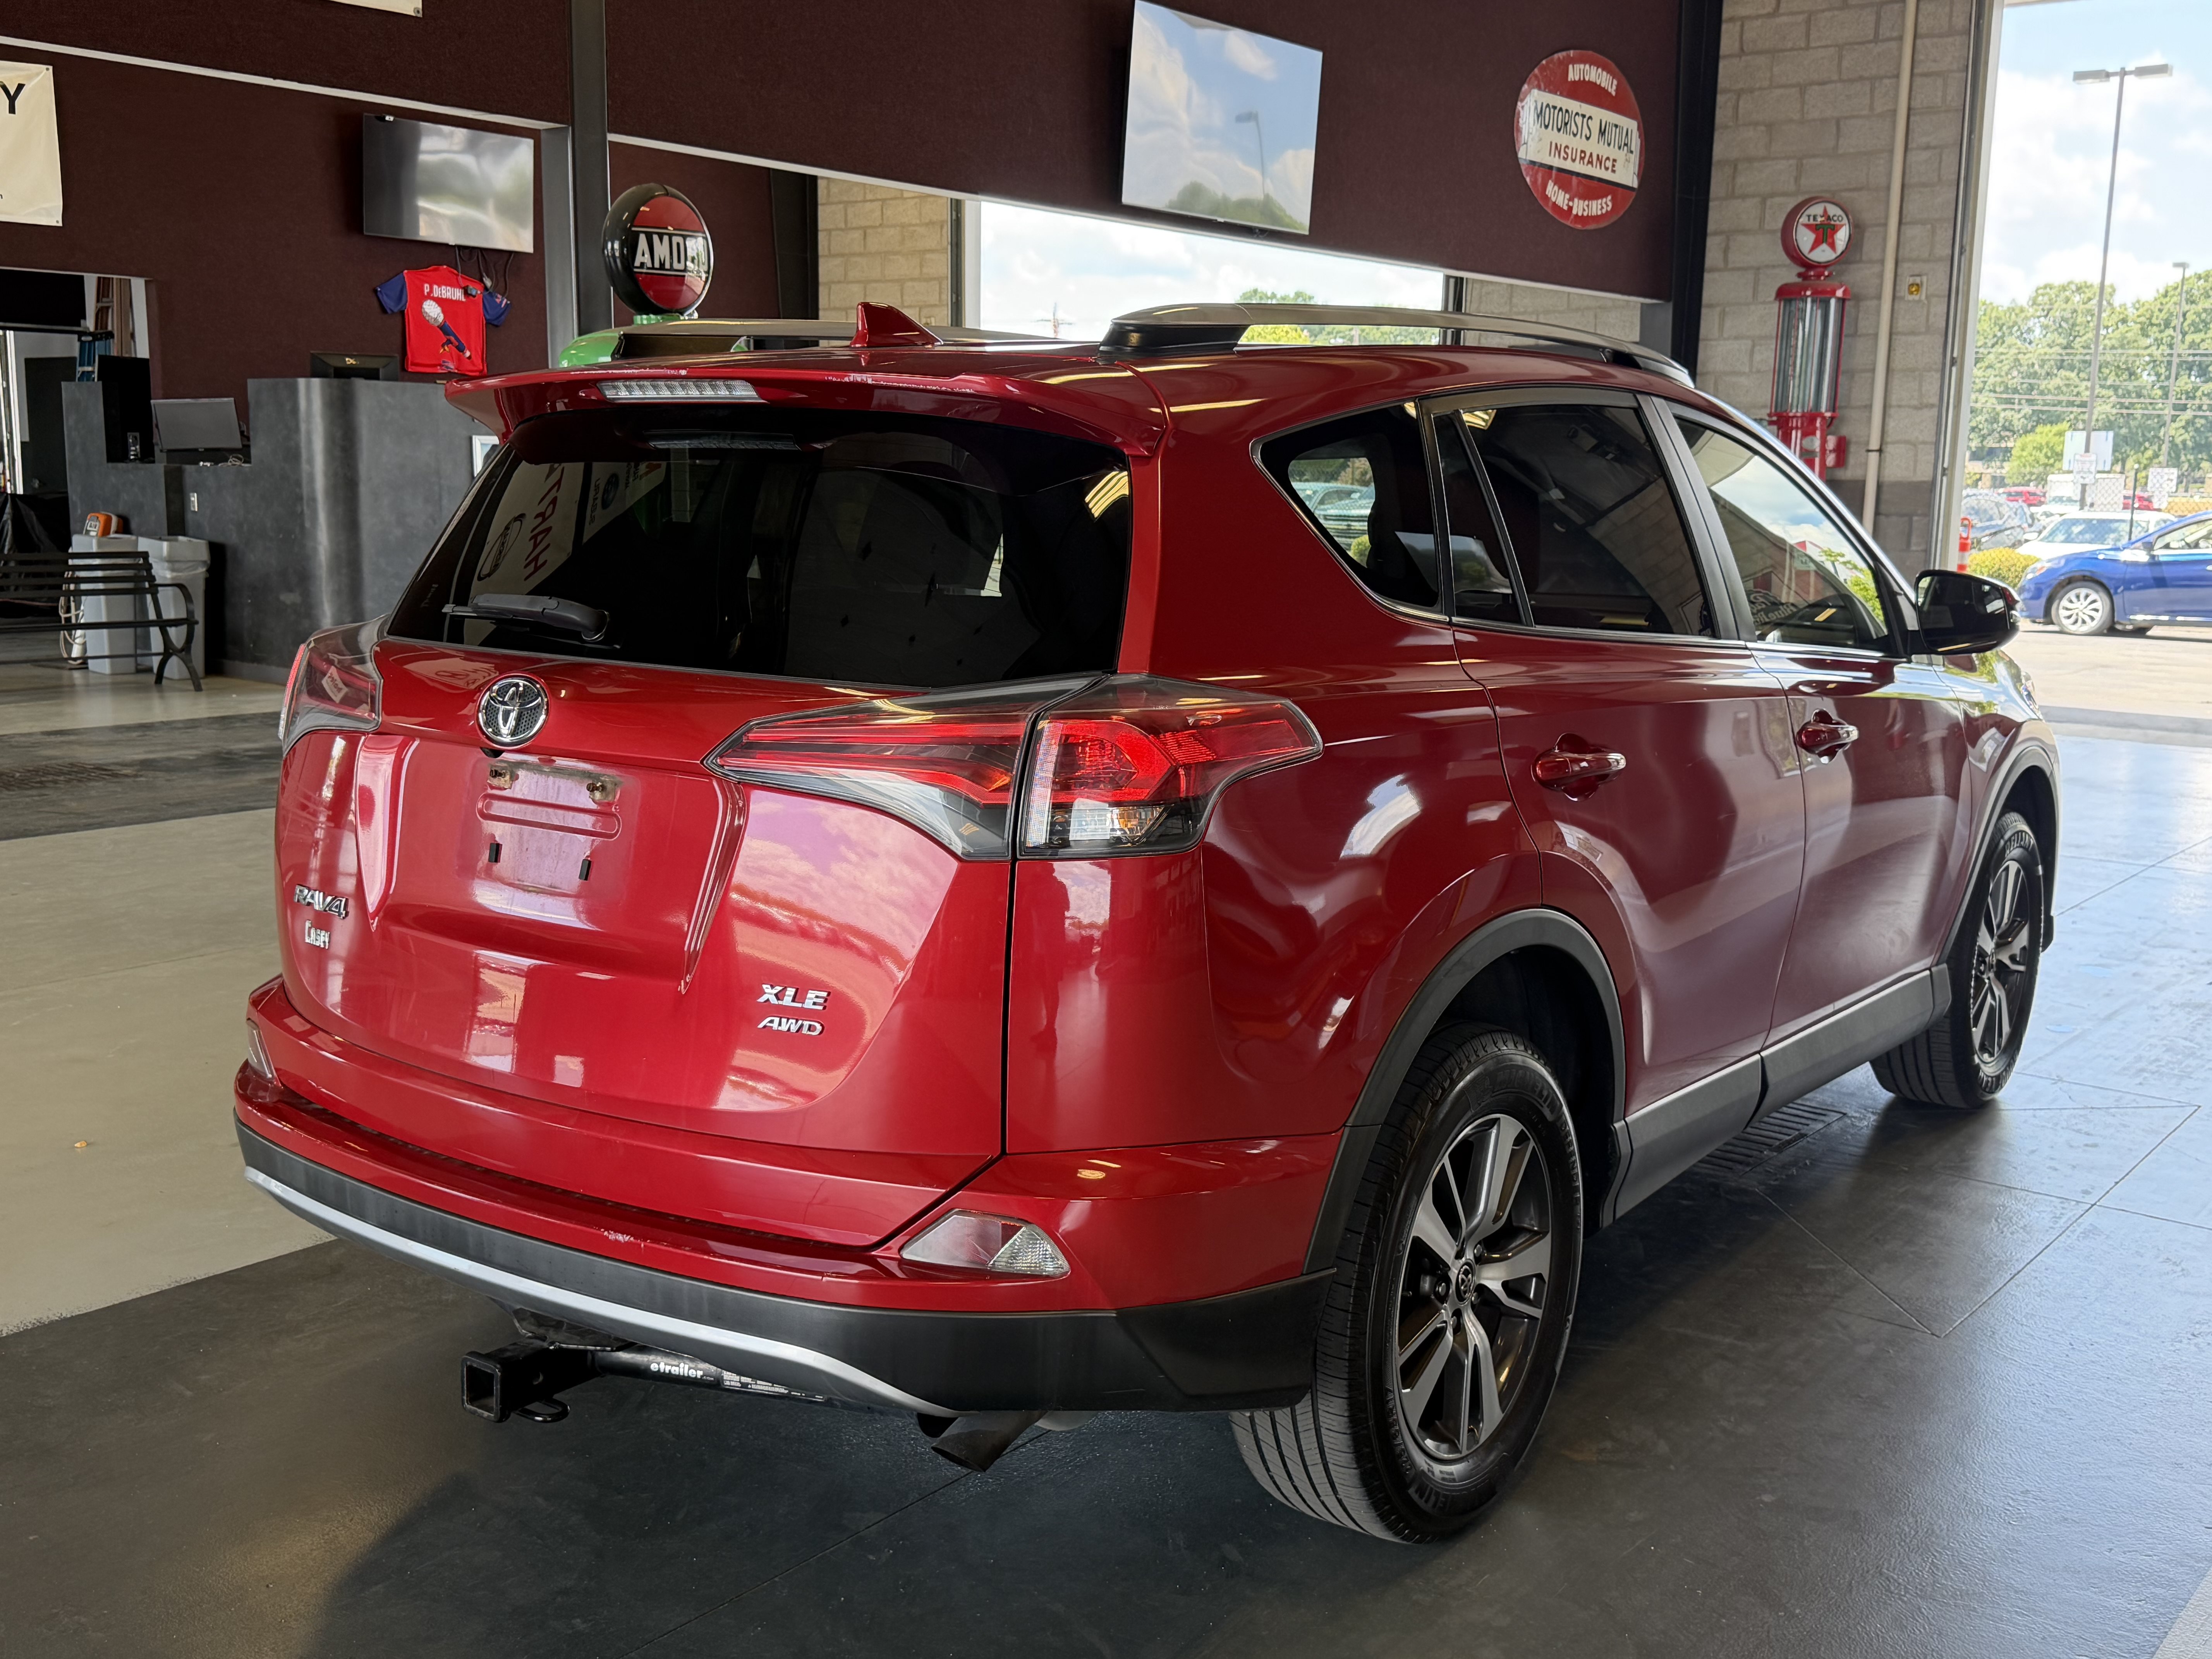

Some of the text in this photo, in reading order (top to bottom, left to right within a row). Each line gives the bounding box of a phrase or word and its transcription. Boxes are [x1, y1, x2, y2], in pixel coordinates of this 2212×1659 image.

[1568, 64, 1617, 96] AUTOMOBILE
[1532, 100, 1634, 155] MOTORISTS MUTUAL
[1549, 141, 1617, 173] INSURANCE
[1546, 180, 1613, 216] HOME-BUSINESS
[294, 884, 349, 919] RAV4
[756, 983, 831, 1010] XLE
[757, 1015, 825, 1036] AWD
